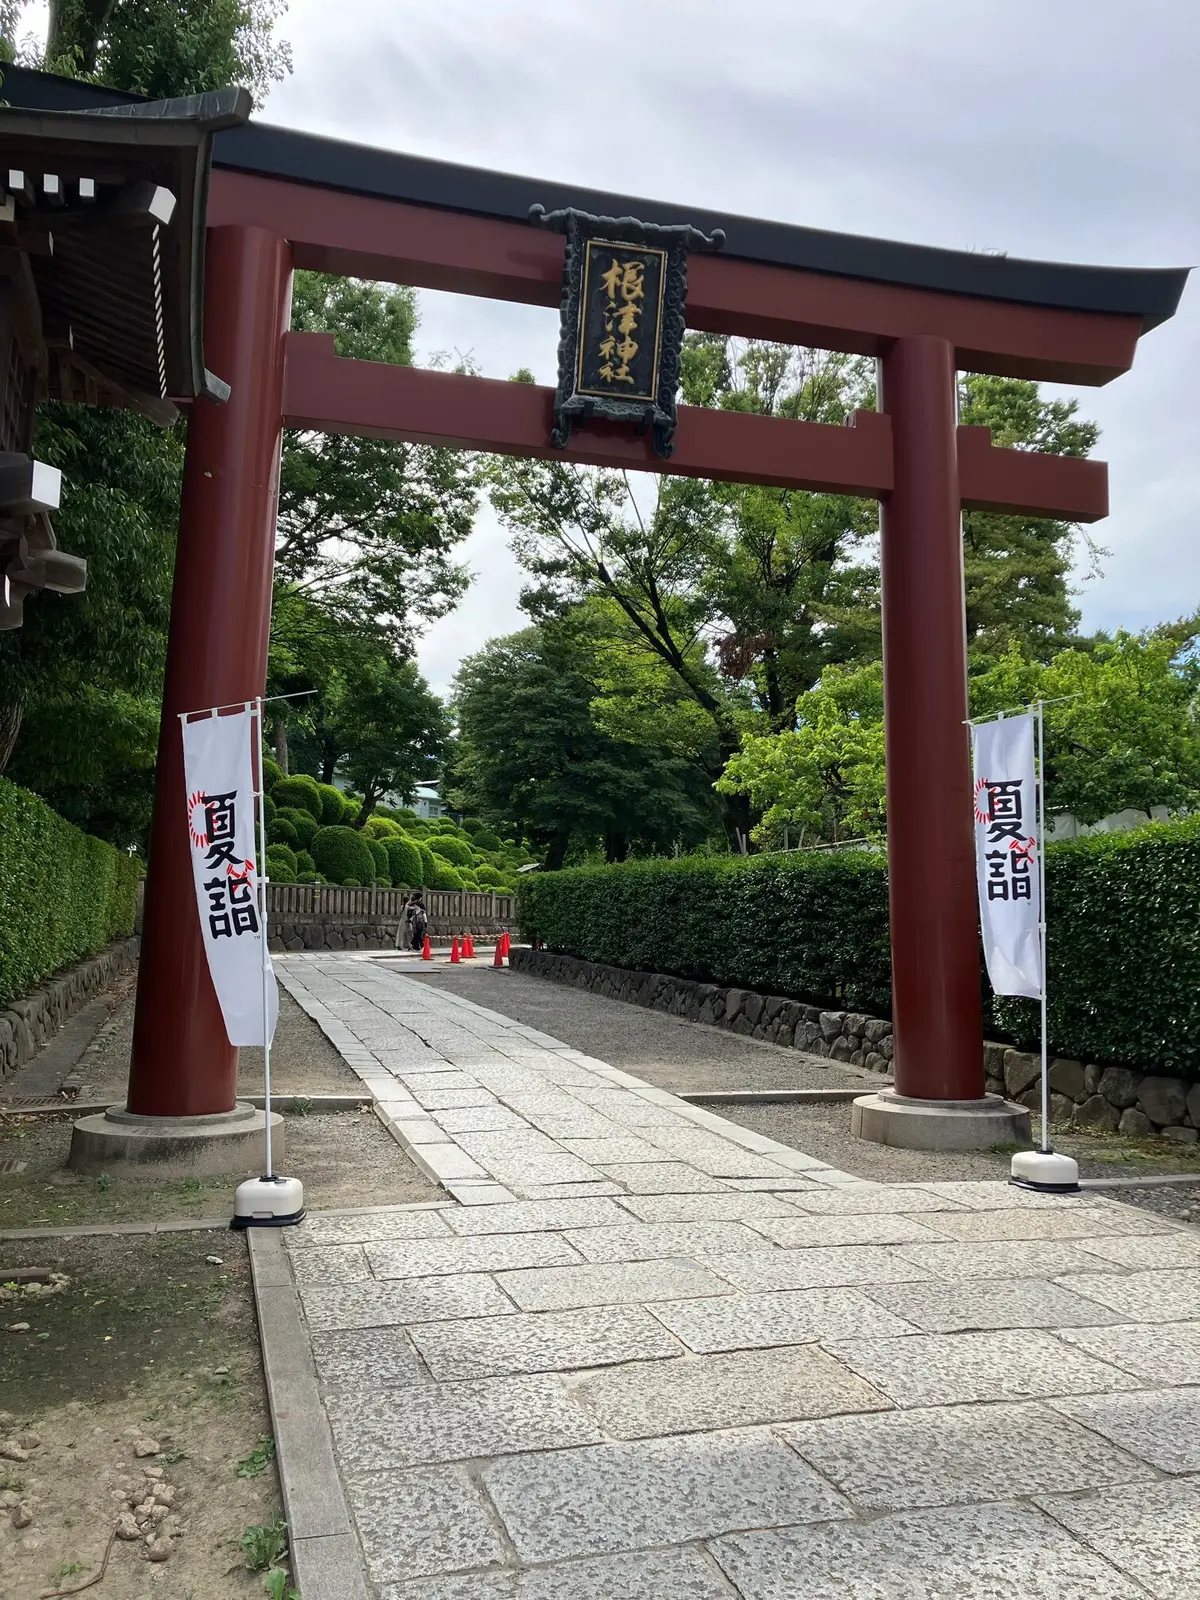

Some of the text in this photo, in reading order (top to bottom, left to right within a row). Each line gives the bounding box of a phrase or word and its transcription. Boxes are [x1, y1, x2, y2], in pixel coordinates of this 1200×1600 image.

[598, 258, 645, 385] 根津神社
[199, 789, 259, 940] 夏詣
[984, 778, 1031, 901] 夏詣
